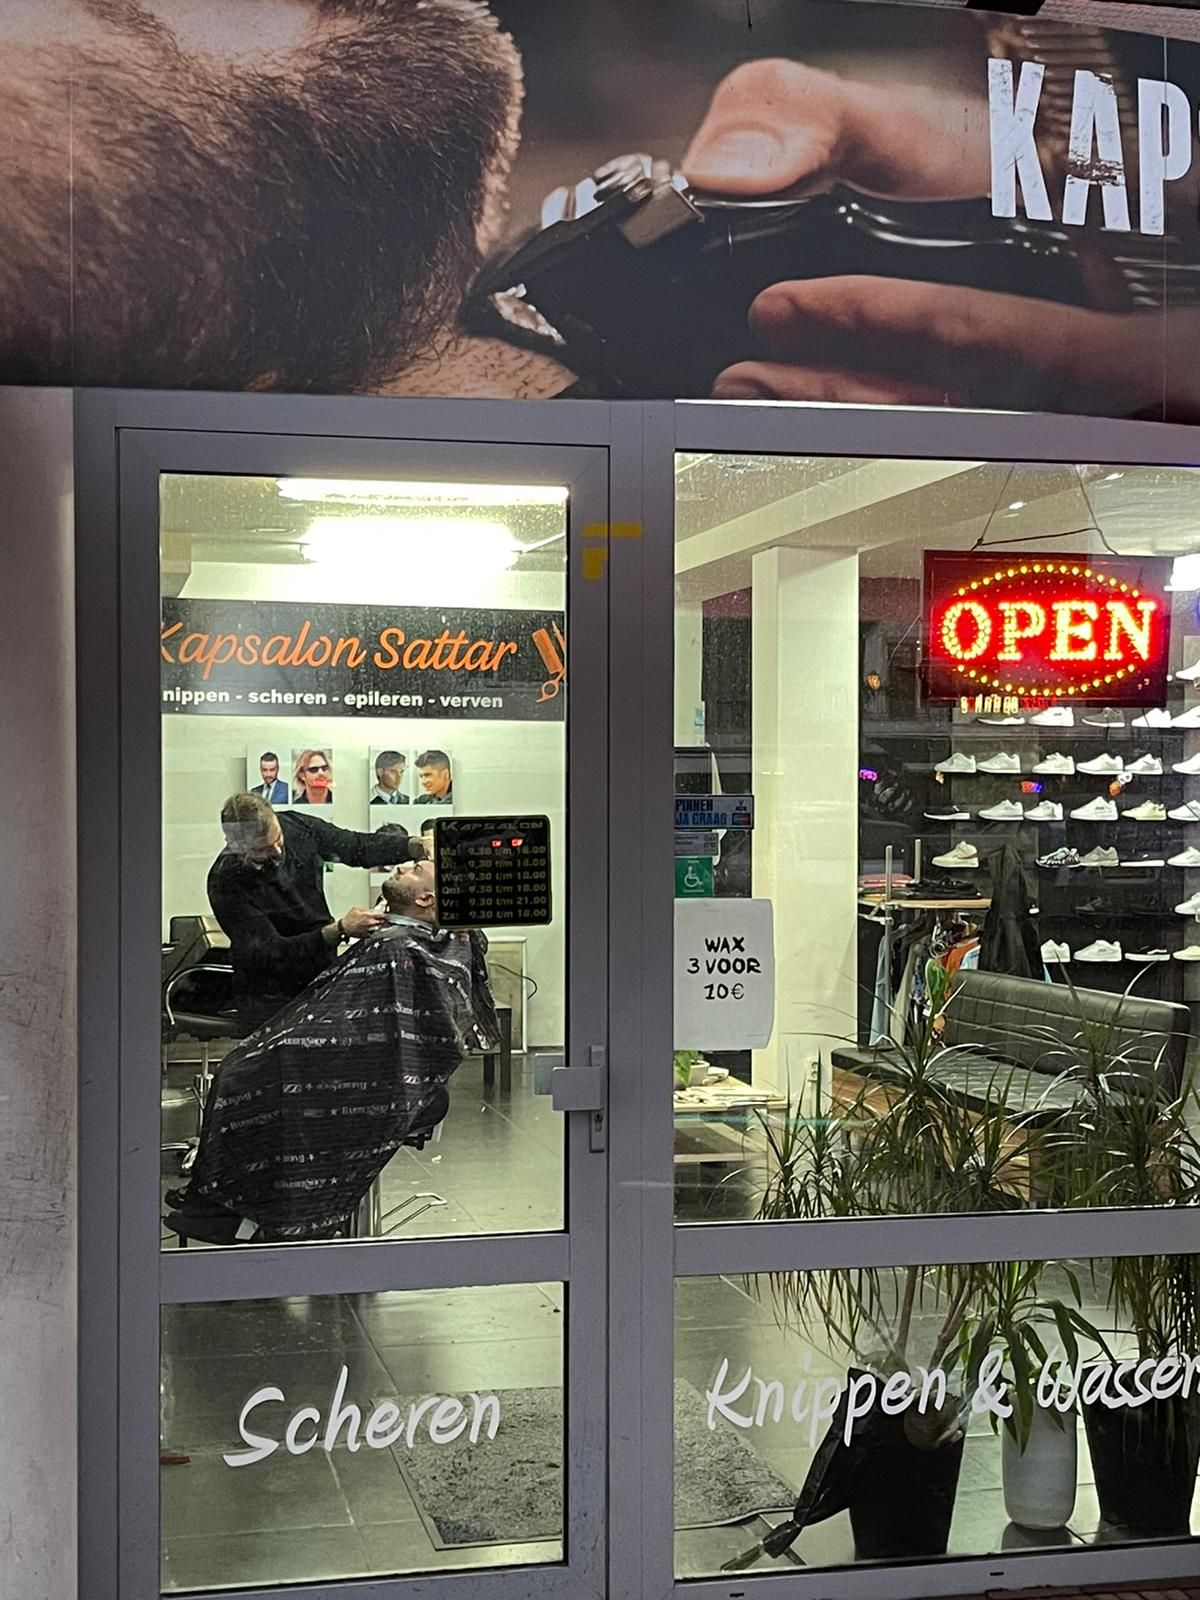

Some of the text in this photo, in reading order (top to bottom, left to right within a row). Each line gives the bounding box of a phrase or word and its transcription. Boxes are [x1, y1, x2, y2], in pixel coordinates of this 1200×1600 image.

[988, 58, 1200, 236] KAP
[373, 627, 518, 672] Sattar
[941, 601, 1157, 661] OPEN
[162, 686, 230, 705] nippen
[248, 688, 328, 705] scheren
[344, 690, 423, 709] epileren
[440, 694, 504, 709] verven
[686, 957, 762, 975] 3 VOOR
[704, 936, 746, 955] WAX
[704, 982, 745, 1000] 10€
[222, 1364, 501, 1468] Scheren
[705, 1350, 947, 1449] Knippen
[971, 1349, 1014, 1419] &
